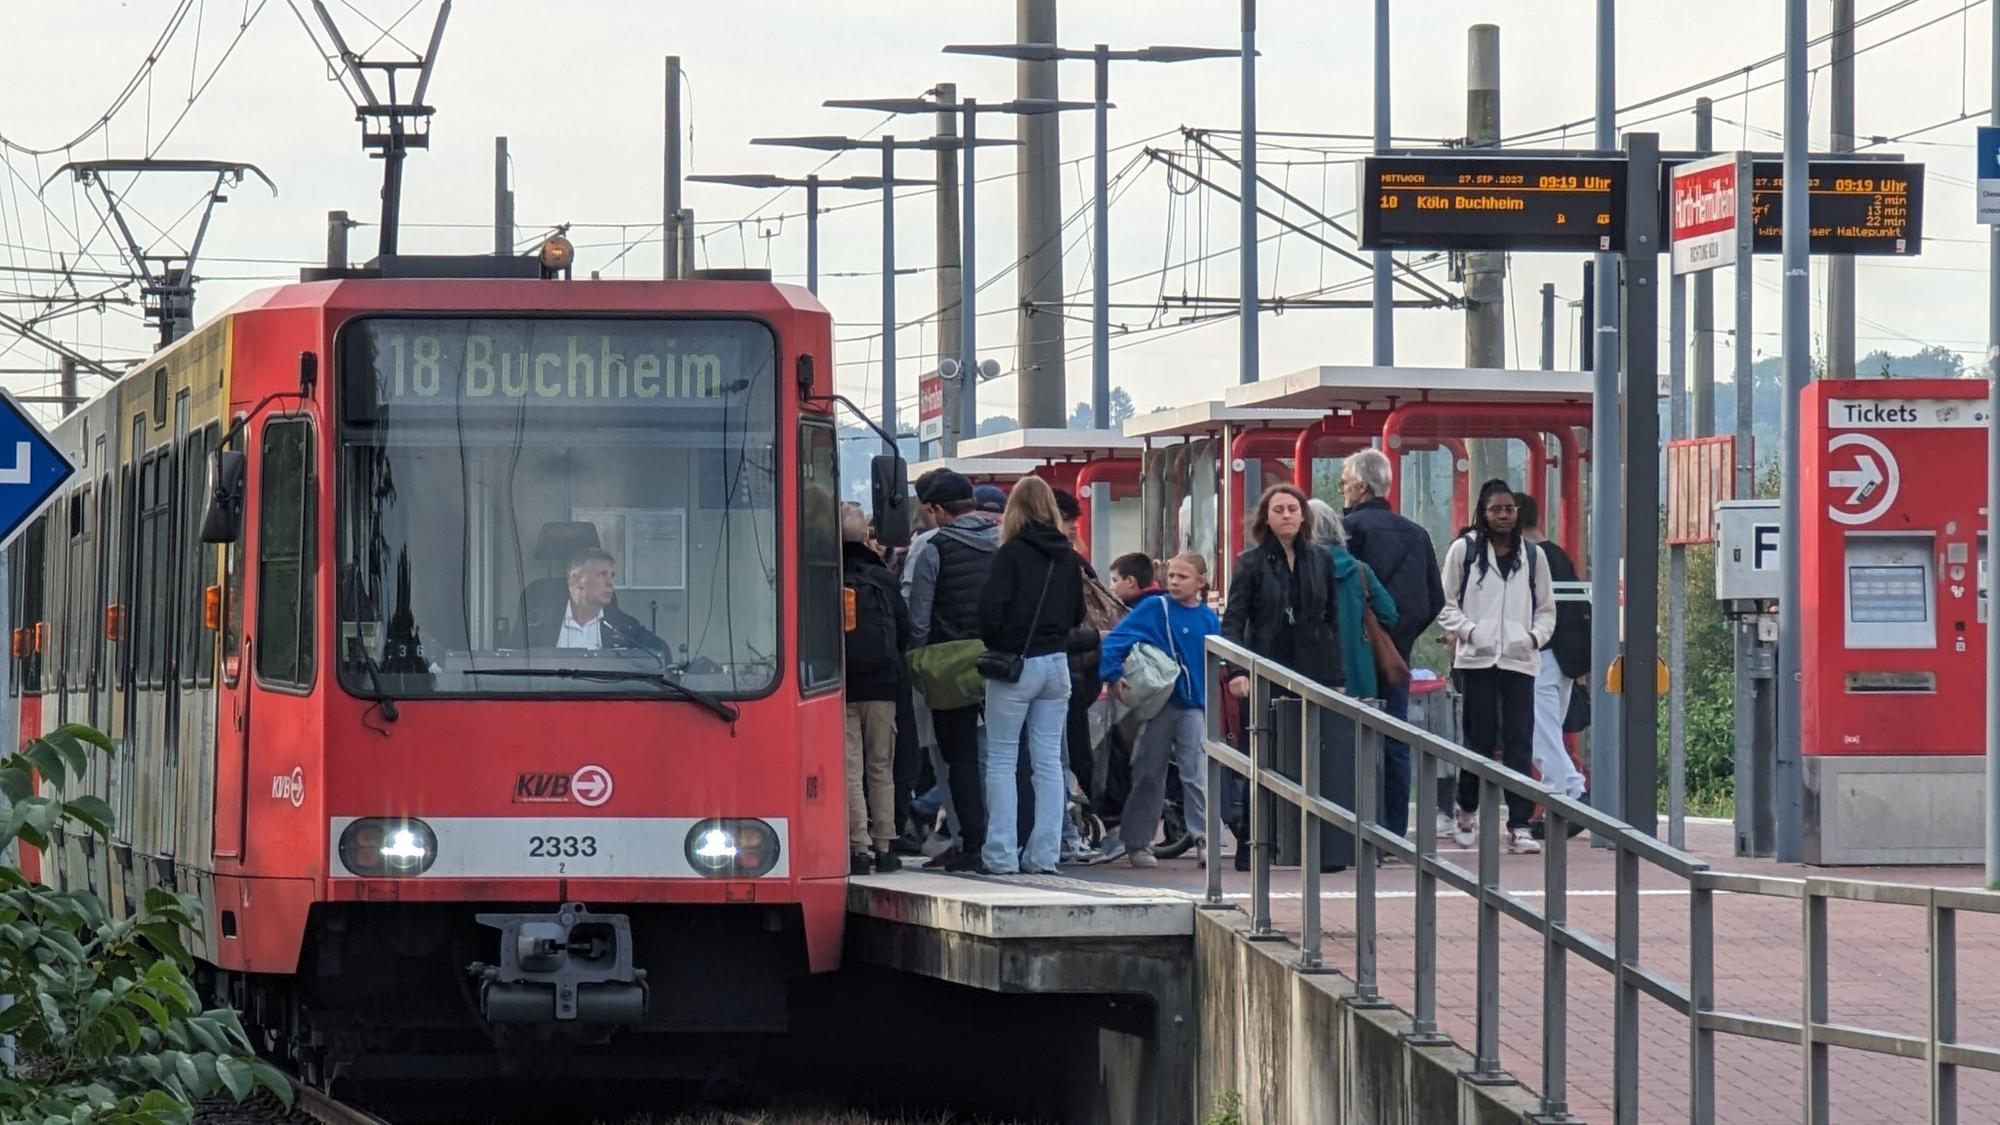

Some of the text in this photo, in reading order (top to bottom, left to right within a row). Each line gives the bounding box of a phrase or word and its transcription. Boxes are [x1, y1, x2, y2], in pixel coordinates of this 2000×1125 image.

[1381, 174, 1425, 183] MITTWOCH
[1539, 176, 1577, 189] 09:19
[1584, 176, 1612, 189] Uhr
[1835, 179, 1874, 192] 09:19
[1880, 179, 1907, 192] Uhr
[1417, 196, 1449, 209] Köln
[1455, 196, 1524, 210] Buchheim
[1874, 195, 1907, 205] 2 min
[1867, 206, 1907, 216] 13 min
[1866, 216, 1906, 227] 22 min
[1837, 226, 1902, 238] Haltepunkt
[390, 335, 721, 398] 18 Buchheim
[1844, 403, 1918, 423] Tickets
[1754, 526, 1780, 569] F
[271, 775, 291, 799] KVB
[517, 775, 570, 797] KVB
[528, 836, 597, 857] 2333
[559, 863, 565, 873] 2
